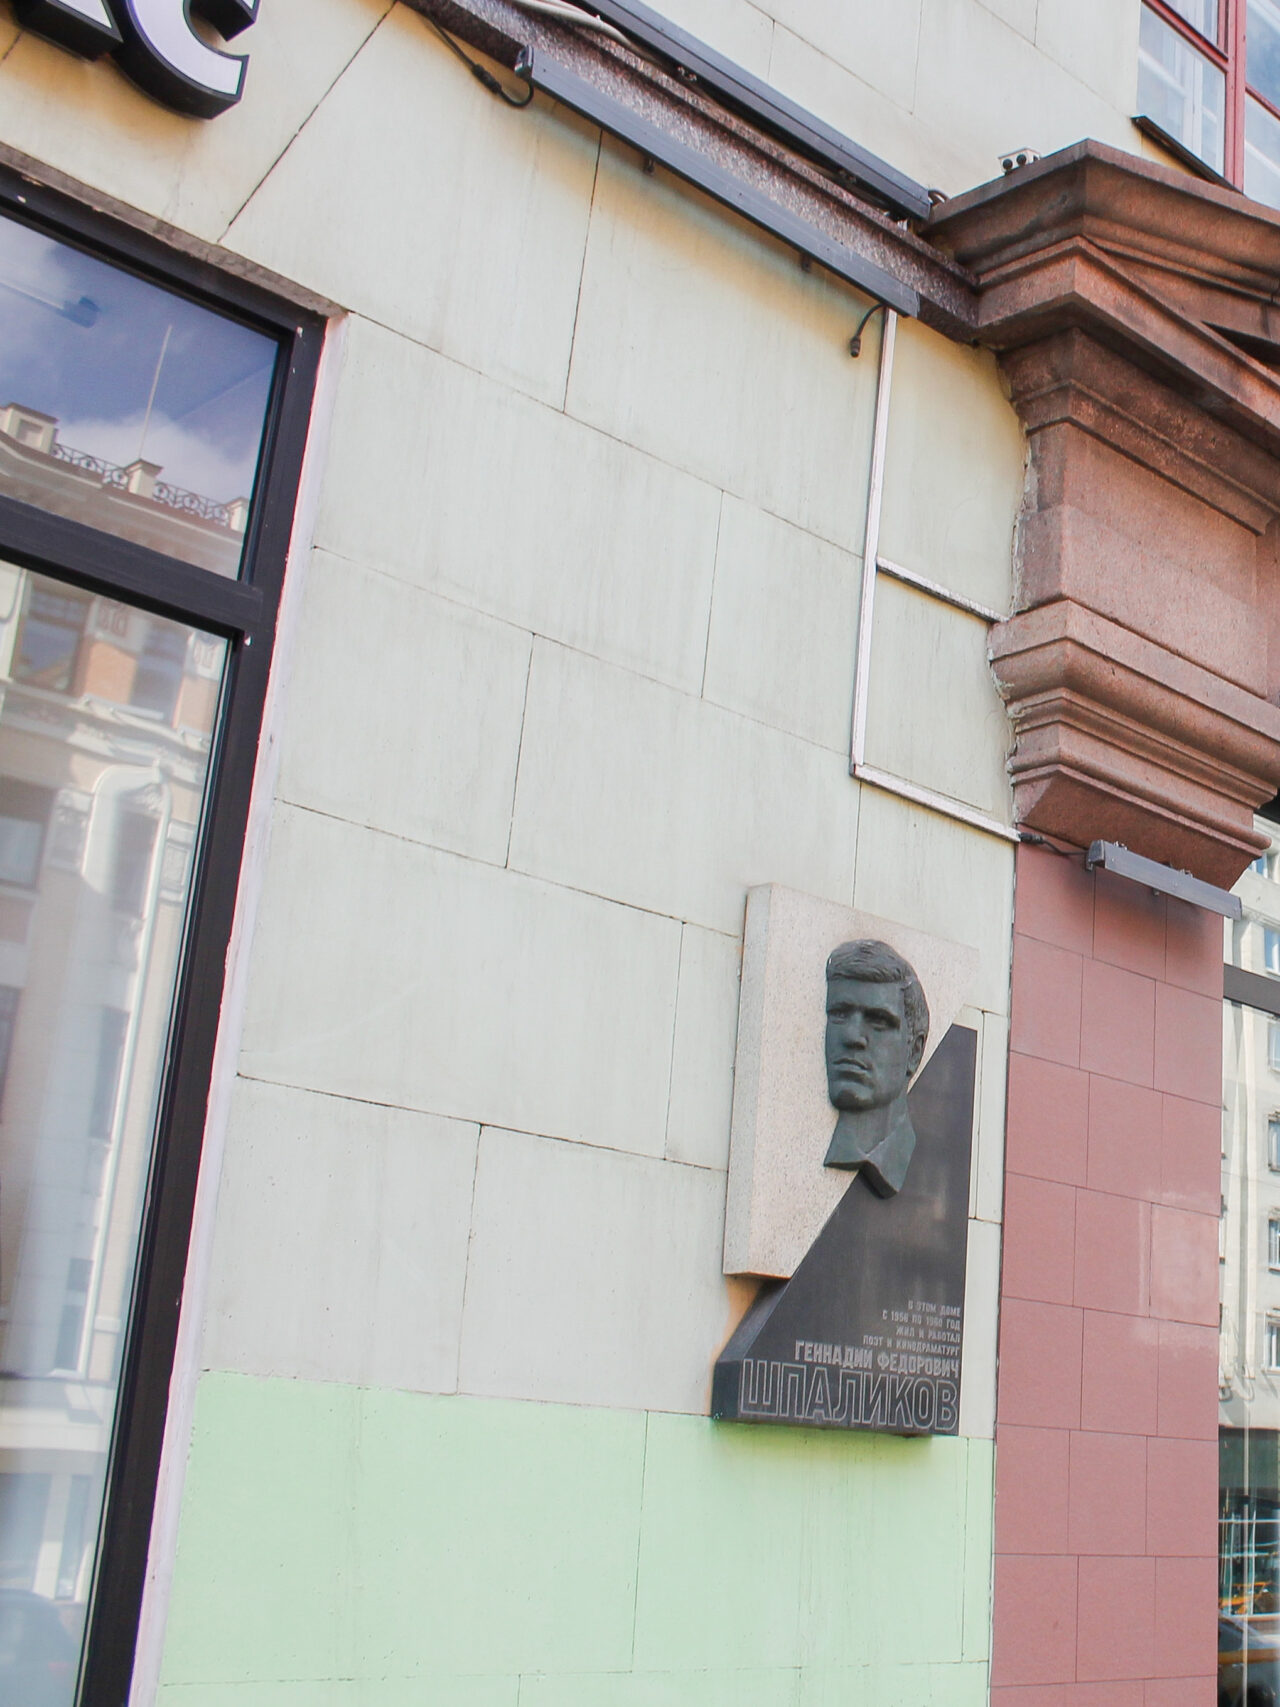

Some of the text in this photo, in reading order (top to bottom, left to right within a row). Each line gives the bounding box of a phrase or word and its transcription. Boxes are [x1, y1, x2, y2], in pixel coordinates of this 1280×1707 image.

[916, 1301, 937, 1313] ЭТОМ
[940, 1305, 961, 1317] ДОМЕ
[882, 1309, 888, 1320] С
[946, 1318, 961, 1331] ГОД
[896, 1325, 961, 1343] ЖИЛ И РАБОТАЛ
[863, 1335, 961, 1356] ПОЭТ И КИНОДРАМАТУРГ
[795, 1340, 960, 1378] ГЕННАДИЙ ФЕДОРОВИЧ
[741, 1358, 960, 1431] ШПАЛИКОВ
